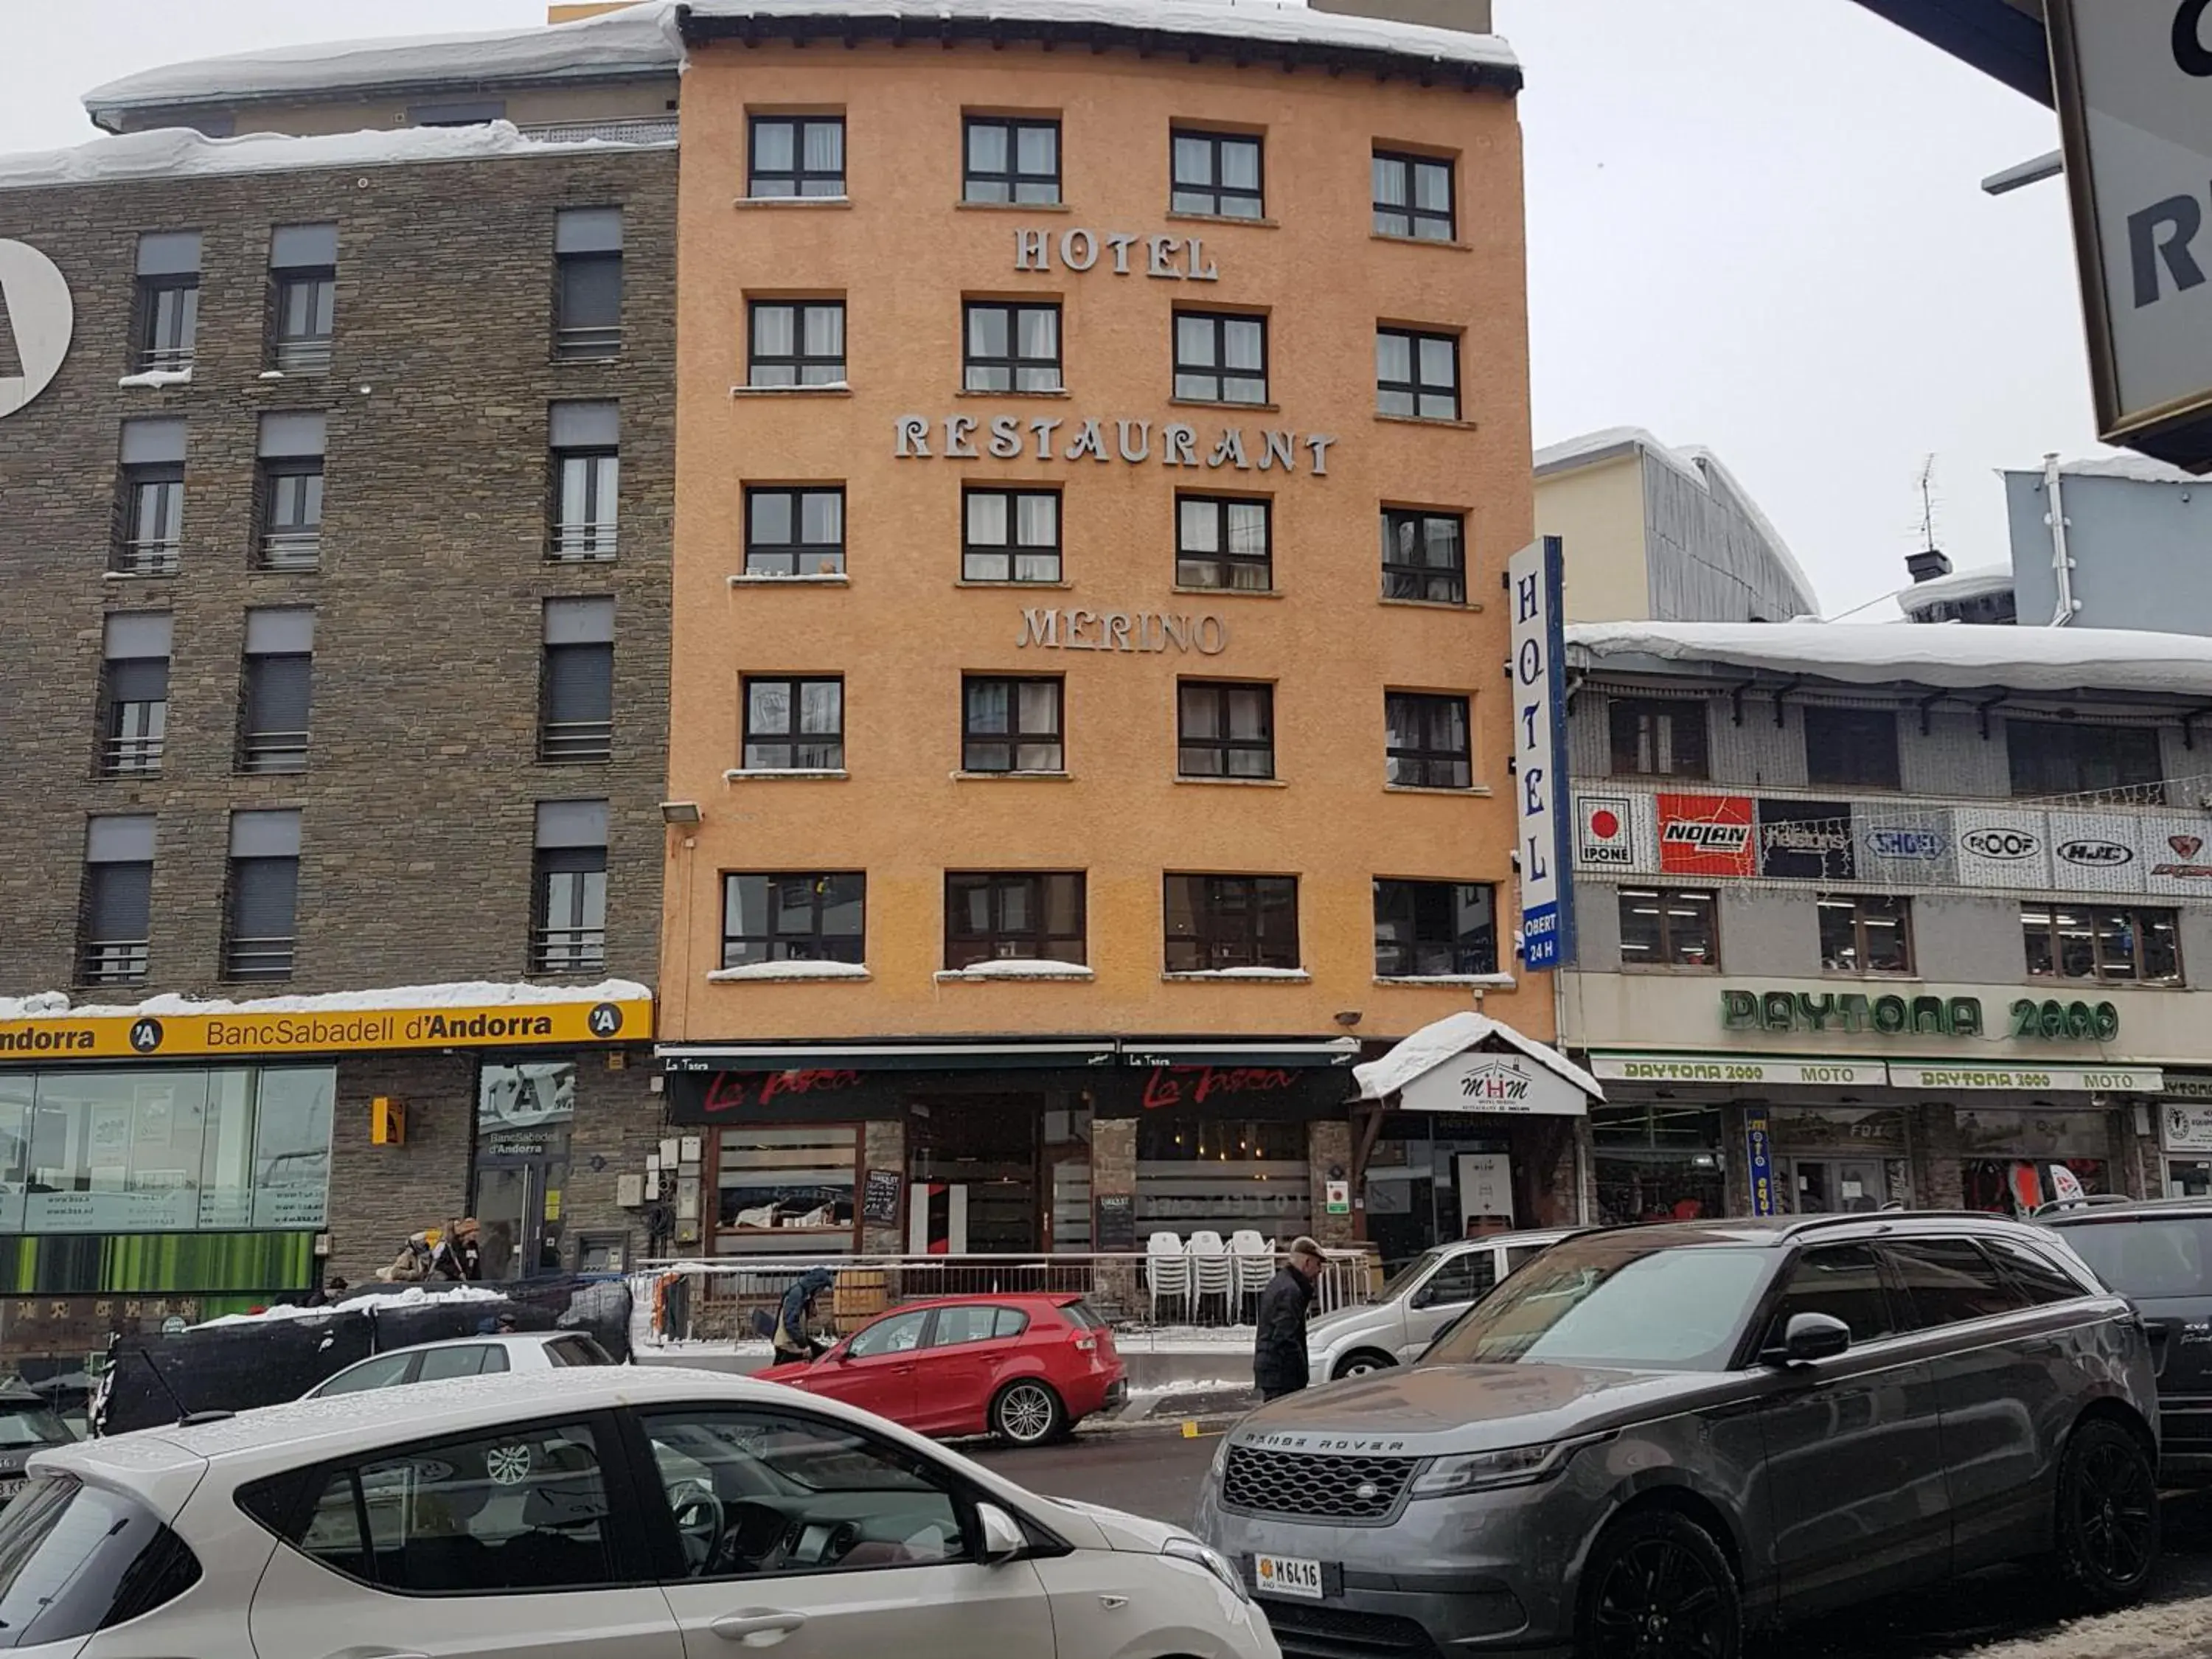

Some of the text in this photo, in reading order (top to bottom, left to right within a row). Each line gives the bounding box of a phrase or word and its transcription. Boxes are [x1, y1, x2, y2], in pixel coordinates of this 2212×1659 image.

[1014, 228, 1218, 281] HOTEL
[894, 414, 1336, 476] RESTAURANT
[1016, 608, 1229, 655] MERINO
[1517, 571, 1547, 883] HOTEL
[1666, 824, 1747, 846] NOLAN
[1970, 834, 2033, 855] ROOF
[1585, 848, 1629, 861] IPONE
[2067, 844, 2121, 860] HJC
[1526, 914, 1556, 936] OBERT
[1530, 940, 1553, 961] 24 H
[1722, 990, 2118, 1042] DAYTONA 2000
[206, 1013, 552, 1046] BancSabadell d'Andorra
[666, 1058, 678, 1070] La
[1130, 1054, 1141, 1065] La
[1624, 1062, 1854, 1082] DAYTONA 2000 MOTO
[1921, 1071, 2012, 1087] DAYTONA
[2084, 1074, 2133, 1088] MOTO
[1246, 1433, 1403, 1450] RANGE ROVER
